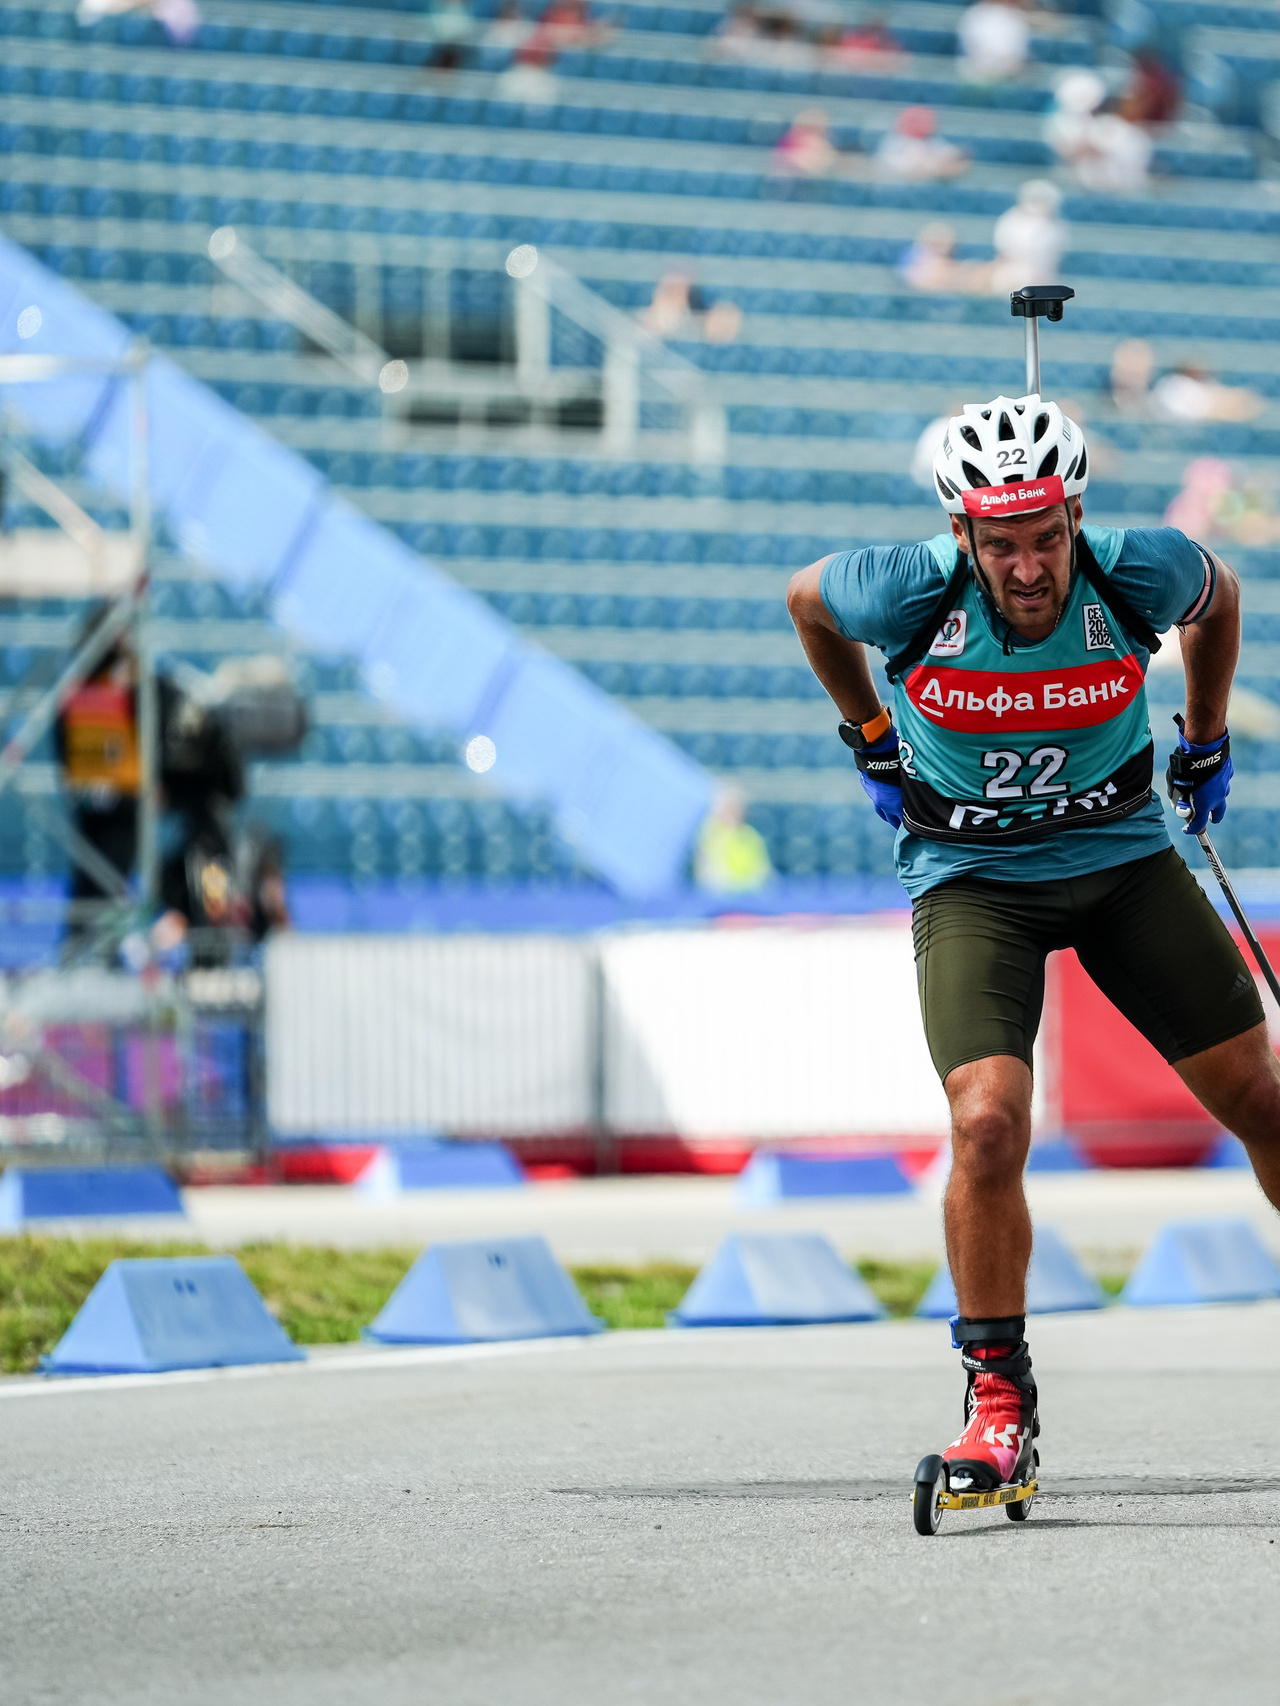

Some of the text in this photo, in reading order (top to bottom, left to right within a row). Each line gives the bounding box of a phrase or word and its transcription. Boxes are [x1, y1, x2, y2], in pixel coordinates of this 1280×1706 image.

[997, 448, 1028, 469] 22
[981, 486, 1046, 508] Альфа Банк
[1088, 620, 1109, 633] 202
[1089, 632, 1112, 647] 202
[919, 675, 1130, 718] Альфа Банк
[981, 746, 1070, 799] 22
